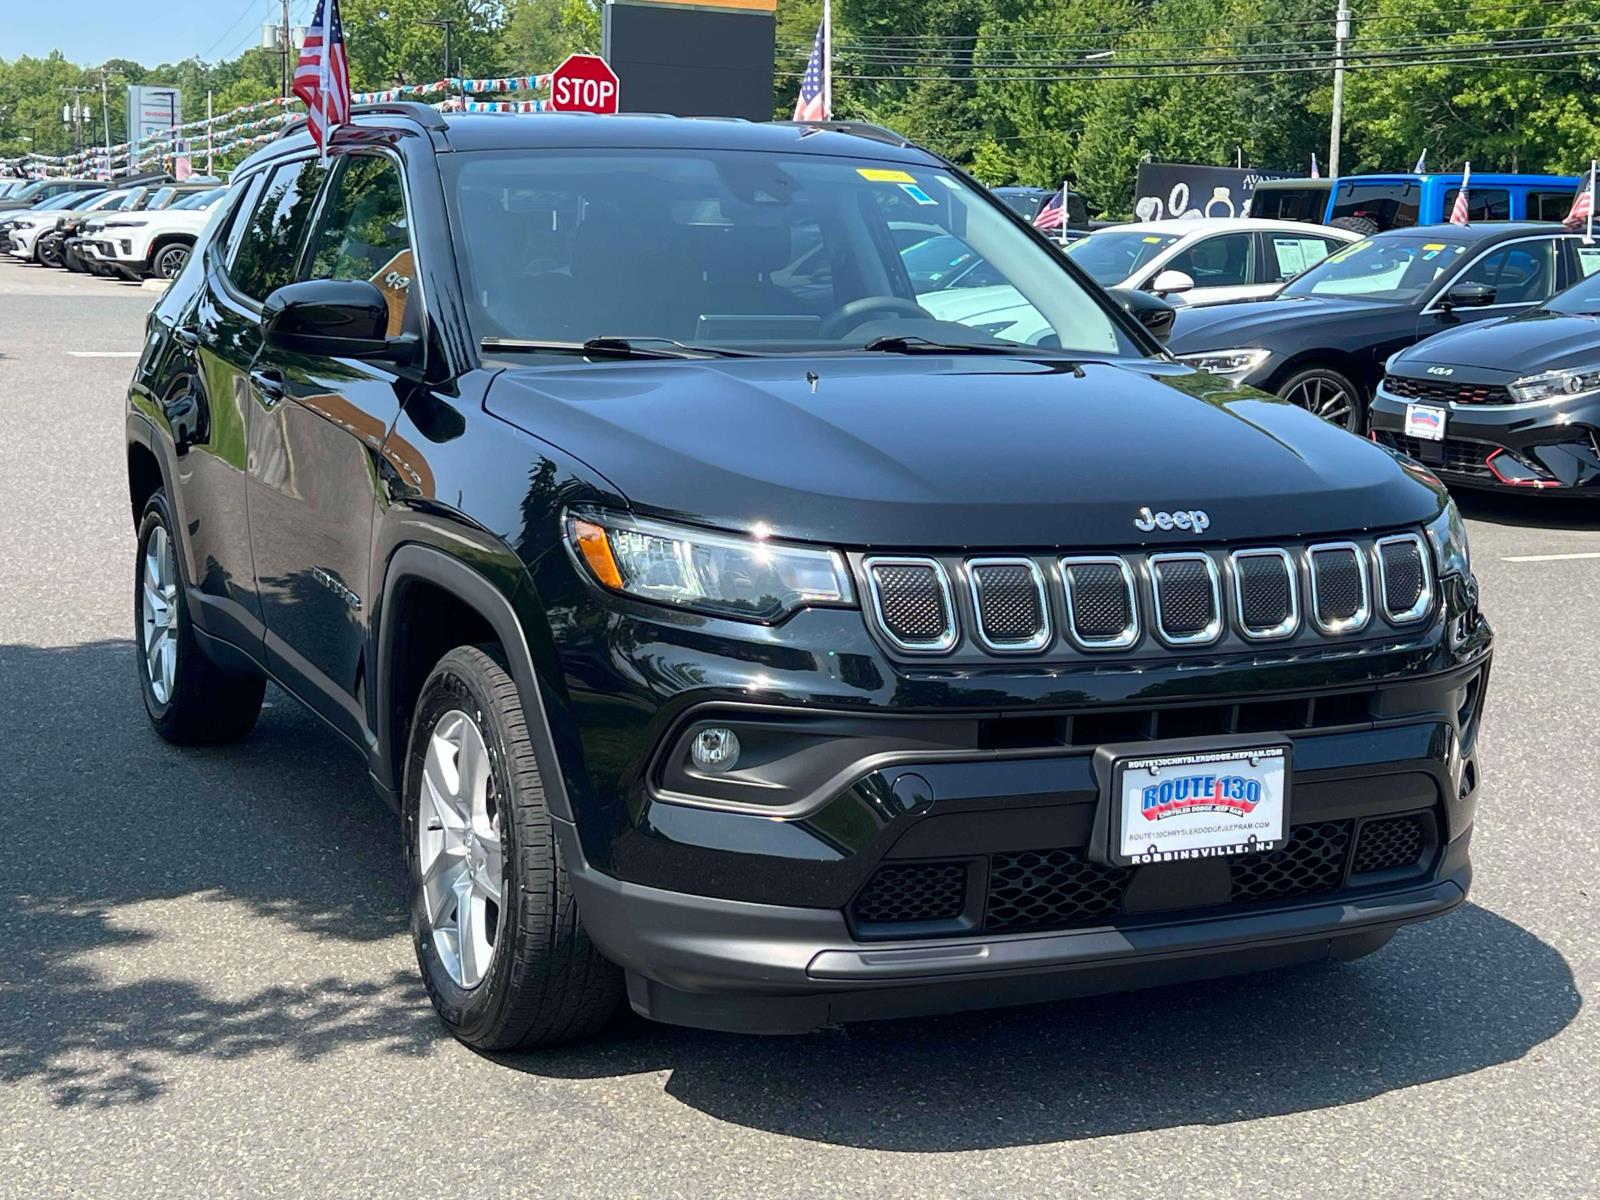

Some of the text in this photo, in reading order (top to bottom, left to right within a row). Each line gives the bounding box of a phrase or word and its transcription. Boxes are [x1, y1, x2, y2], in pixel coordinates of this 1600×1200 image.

[555, 76, 614, 108] STOP
[1427, 366, 1454, 376] KIA
[1135, 506, 1210, 534] Jeep
[1143, 776, 1261, 810] ROUTE 130
[1131, 841, 1274, 865] ROBBINSVILLE, NJ
